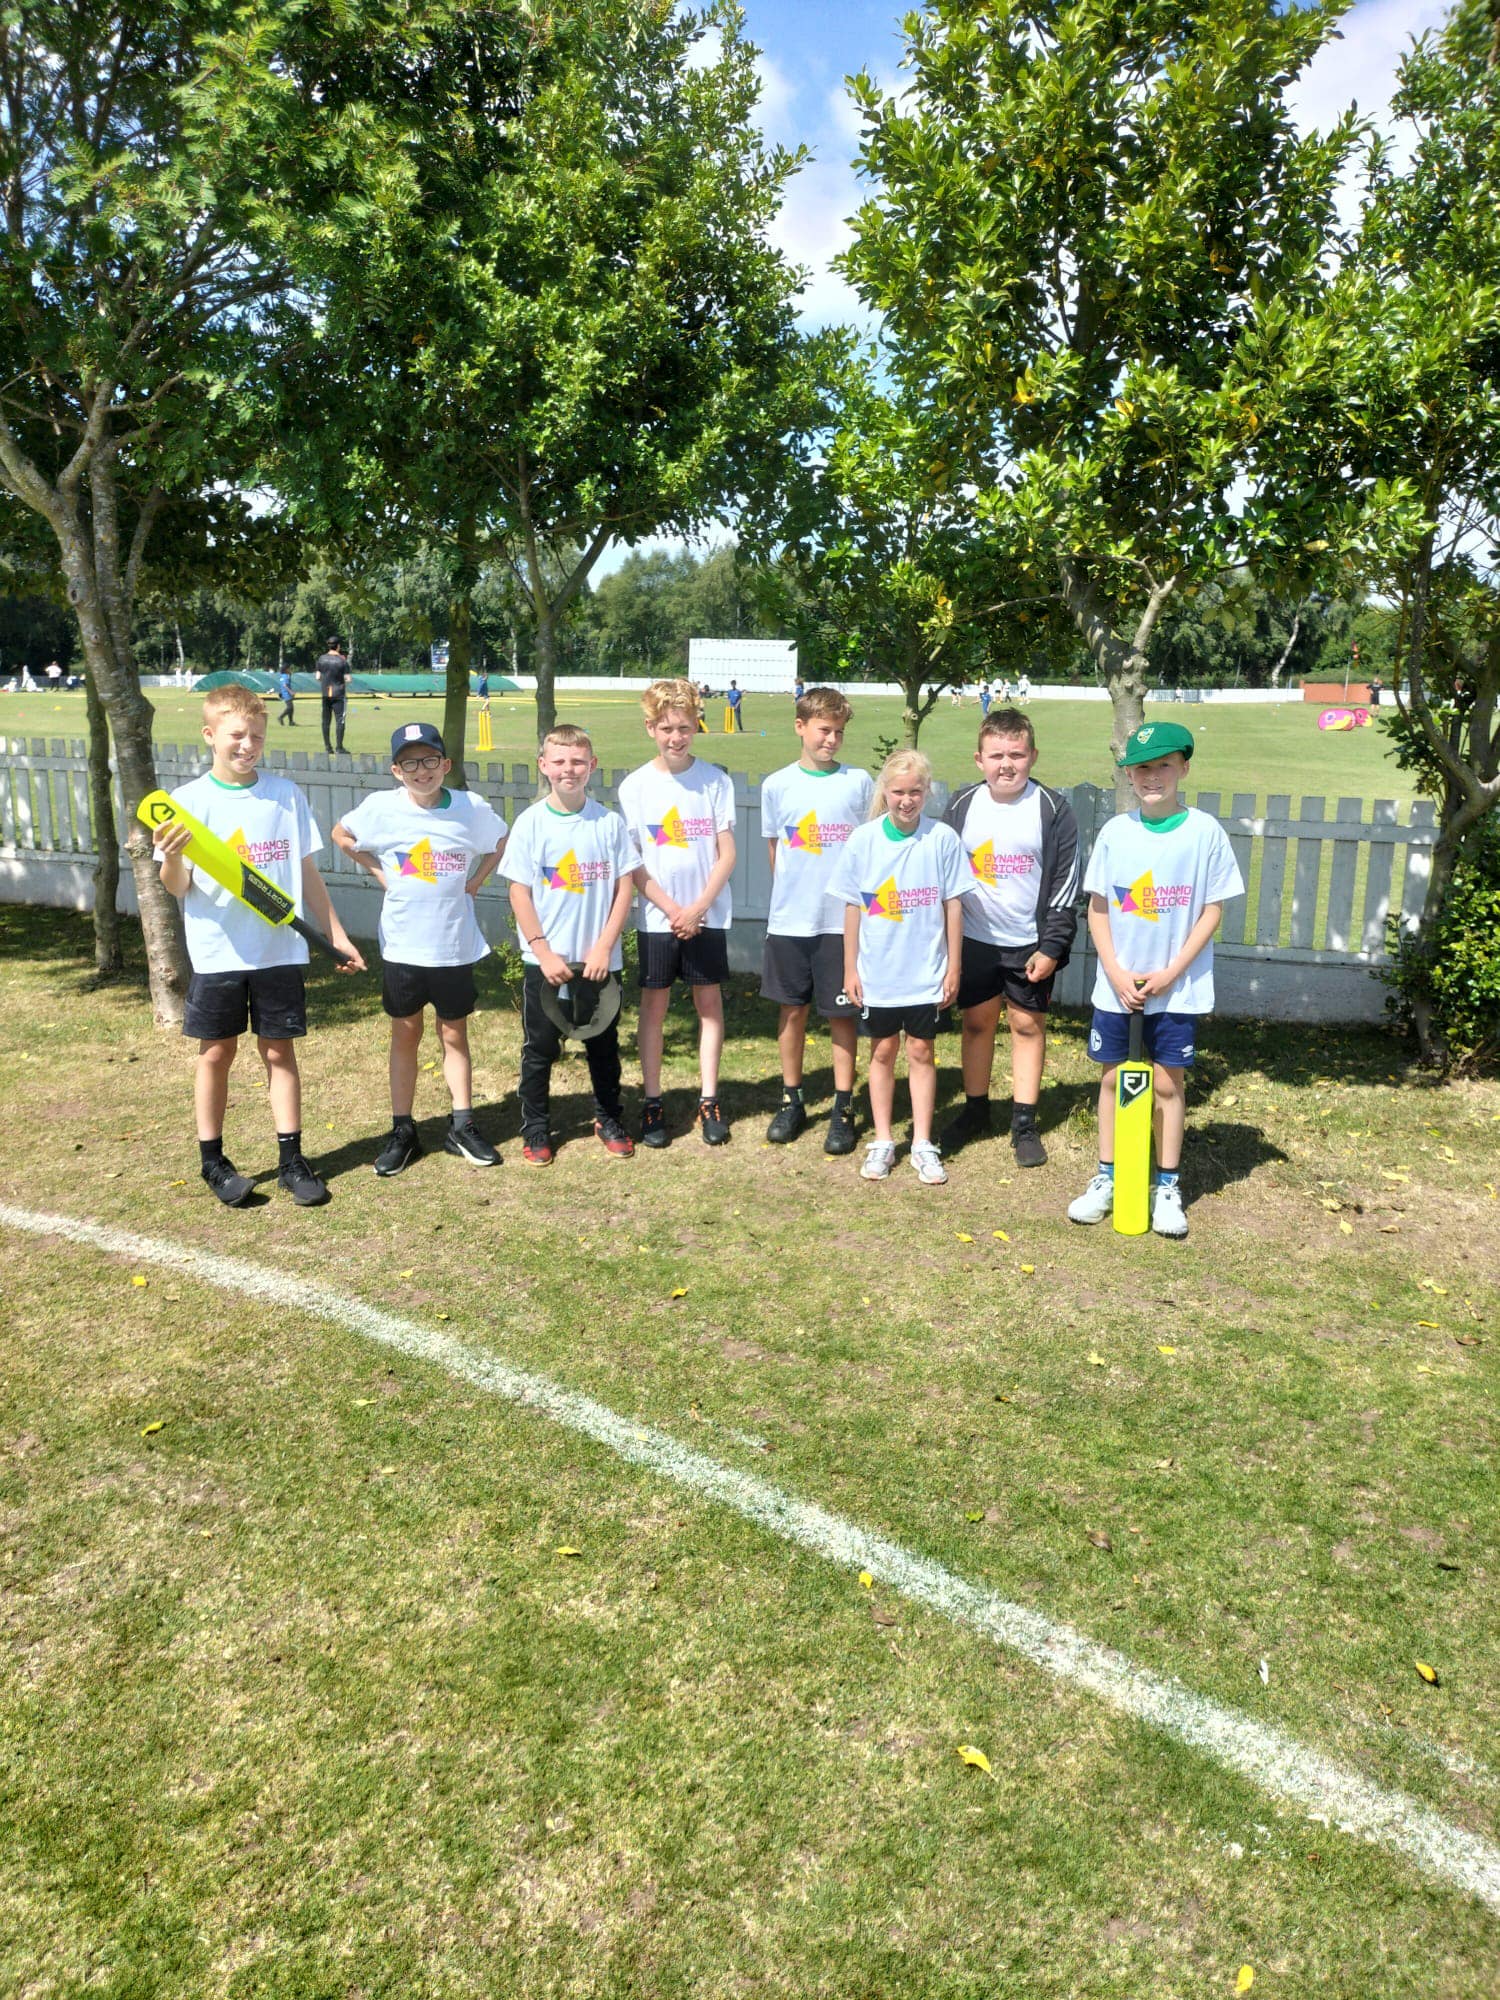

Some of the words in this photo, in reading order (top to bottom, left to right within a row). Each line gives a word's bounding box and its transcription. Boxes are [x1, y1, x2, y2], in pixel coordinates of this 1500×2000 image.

[672, 818, 712, 829] DYNAMO
[673, 827, 713, 837] CRICKE
[808, 832, 849, 842] CRICKE
[237, 839, 290, 855] DYNAMOS
[984, 853, 1035, 864] DYNAMOS
[568, 861, 611, 873] DYNAMS
[984, 863, 1034, 874] CRICKET
[888, 886, 939, 900] DYNAMOS
[1142, 885, 1192, 897] DYNAMO
[888, 897, 938, 910] CRICKET
[1142, 896, 1190, 908] CRICKE
